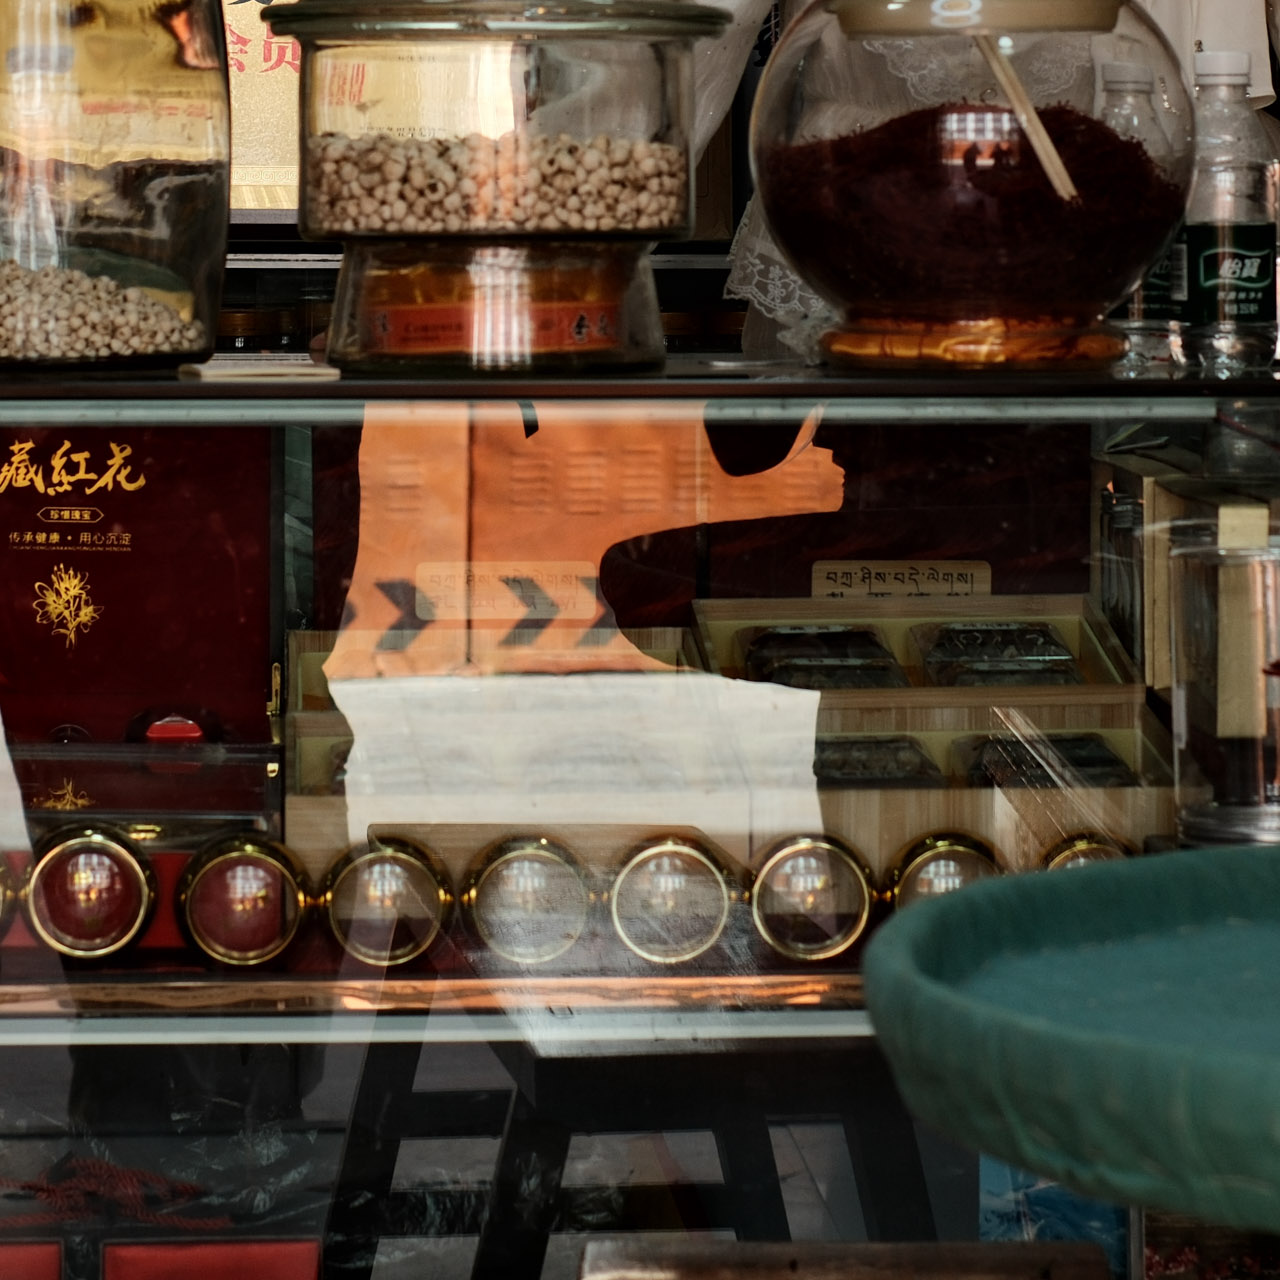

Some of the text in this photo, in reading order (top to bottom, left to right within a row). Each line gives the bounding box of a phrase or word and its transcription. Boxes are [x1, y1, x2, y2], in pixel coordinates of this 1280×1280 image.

[9, 531, 132, 545] 传承健康 用心沉淀
